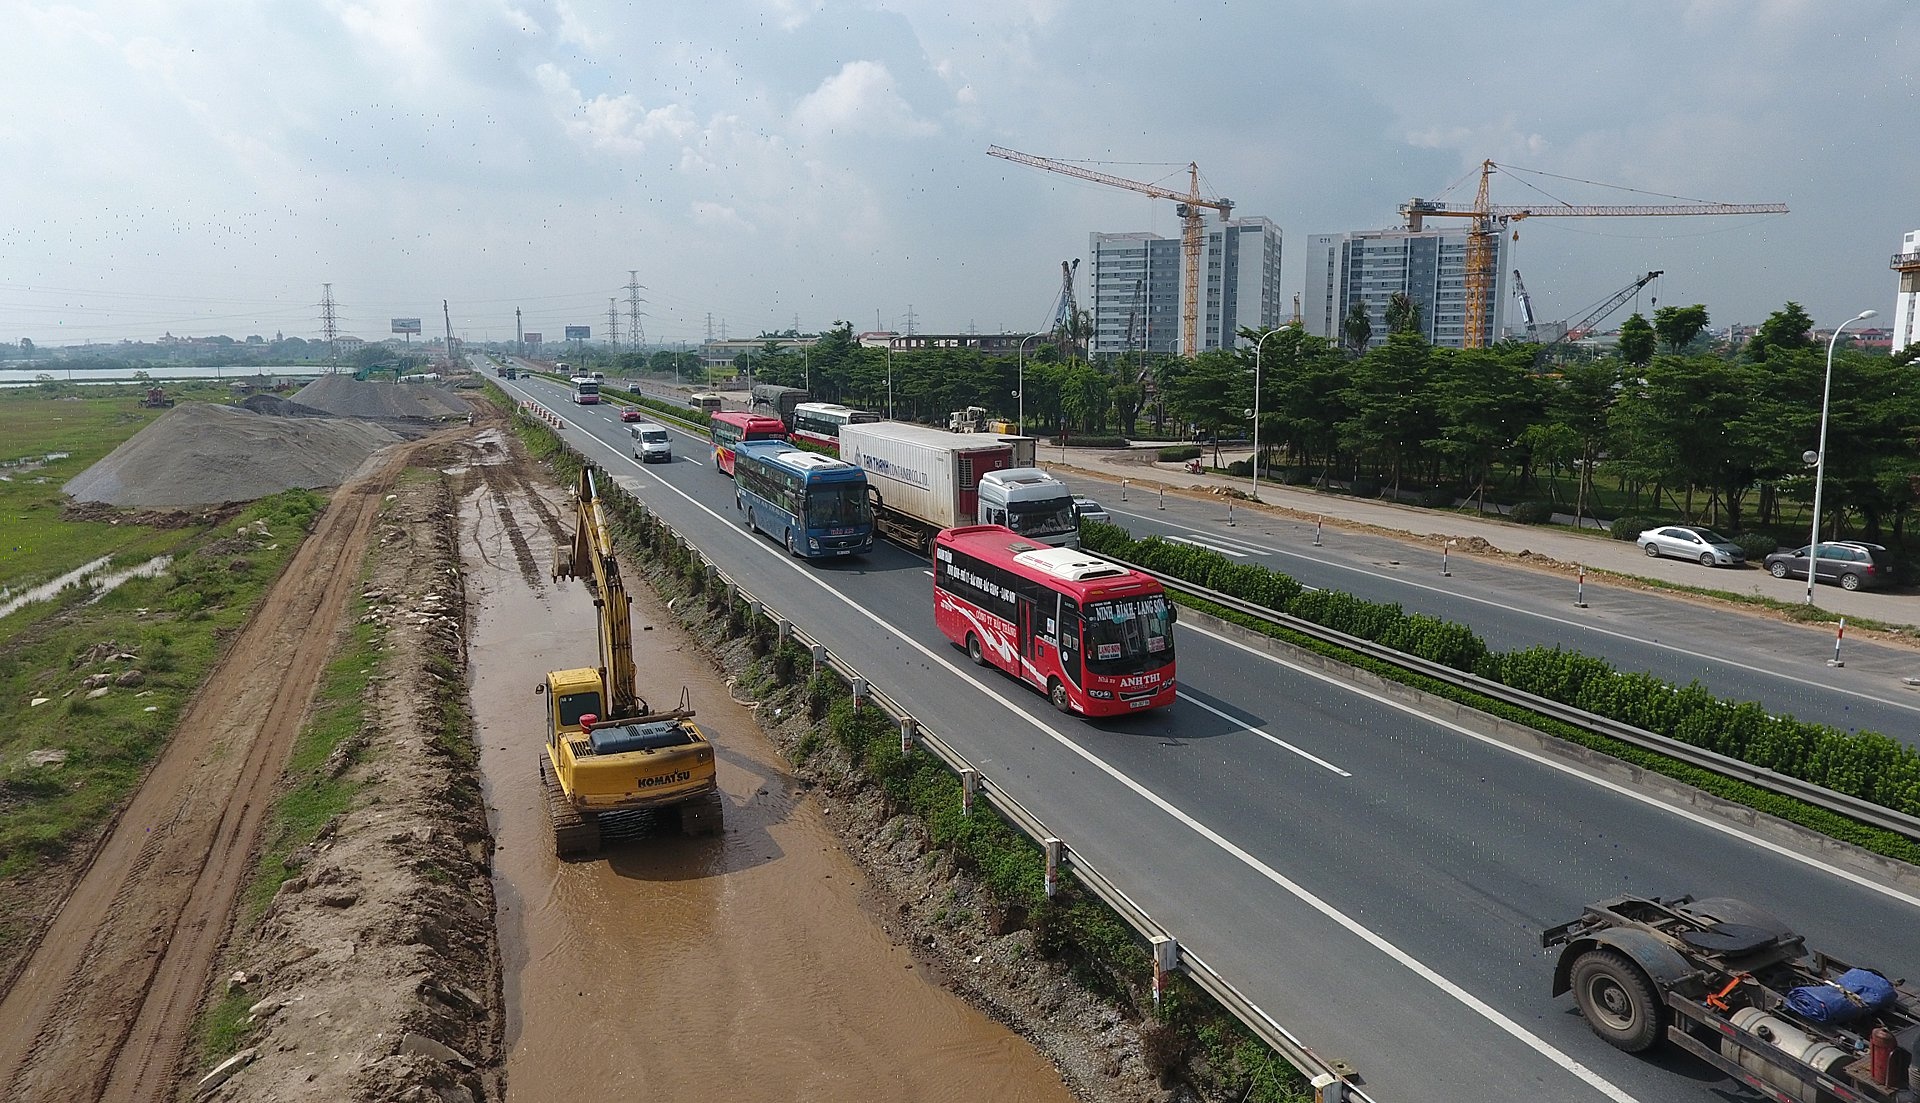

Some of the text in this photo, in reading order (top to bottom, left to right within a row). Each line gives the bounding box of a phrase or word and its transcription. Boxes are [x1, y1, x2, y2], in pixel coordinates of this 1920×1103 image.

[1095, 605, 1114, 621] NINH
[1120, 676, 1143, 688] ANH
[1143, 672, 1160, 684] THI
[638, 770, 690, 788] KOMATSU
